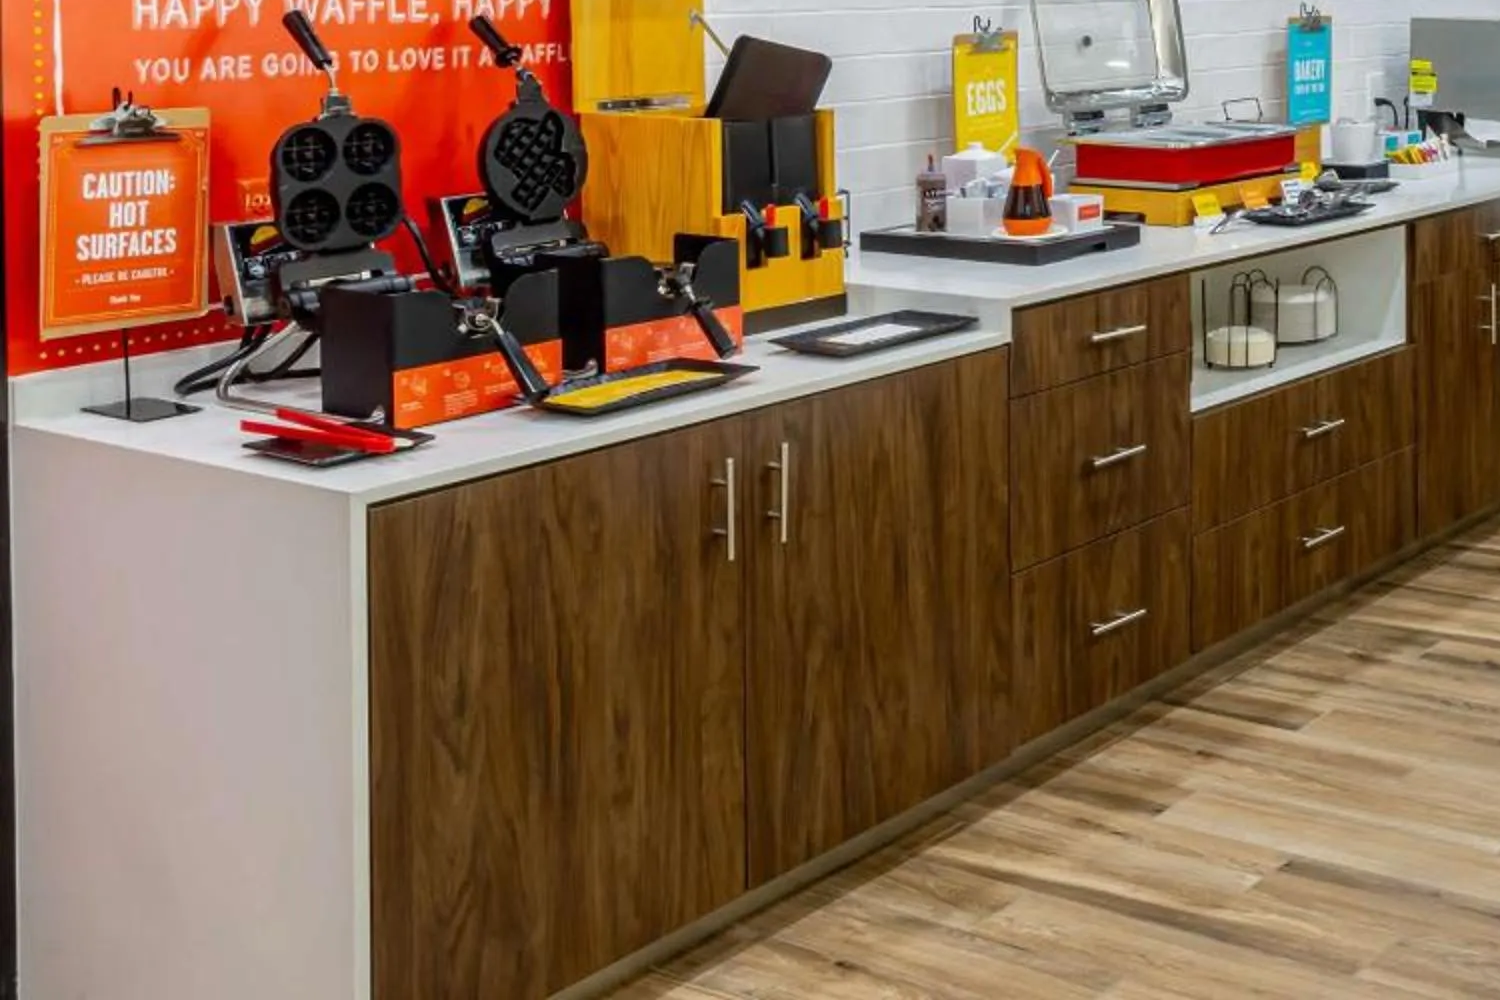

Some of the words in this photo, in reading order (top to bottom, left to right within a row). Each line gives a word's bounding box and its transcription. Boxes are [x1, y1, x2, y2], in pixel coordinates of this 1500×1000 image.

[134, 57, 191, 84] YOU
[200, 55, 252, 81] ARE
[348, 49, 380, 74] TO
[387, 46, 445, 73] LOVE
[452, 45, 471, 69] IT
[509, 42, 571, 65] AFFL
[966, 78, 1007, 116] EGGS
[82, 168, 176, 199] CAUTION:
[109, 200, 149, 228] HOT
[76, 228, 177, 261] SURFACES
